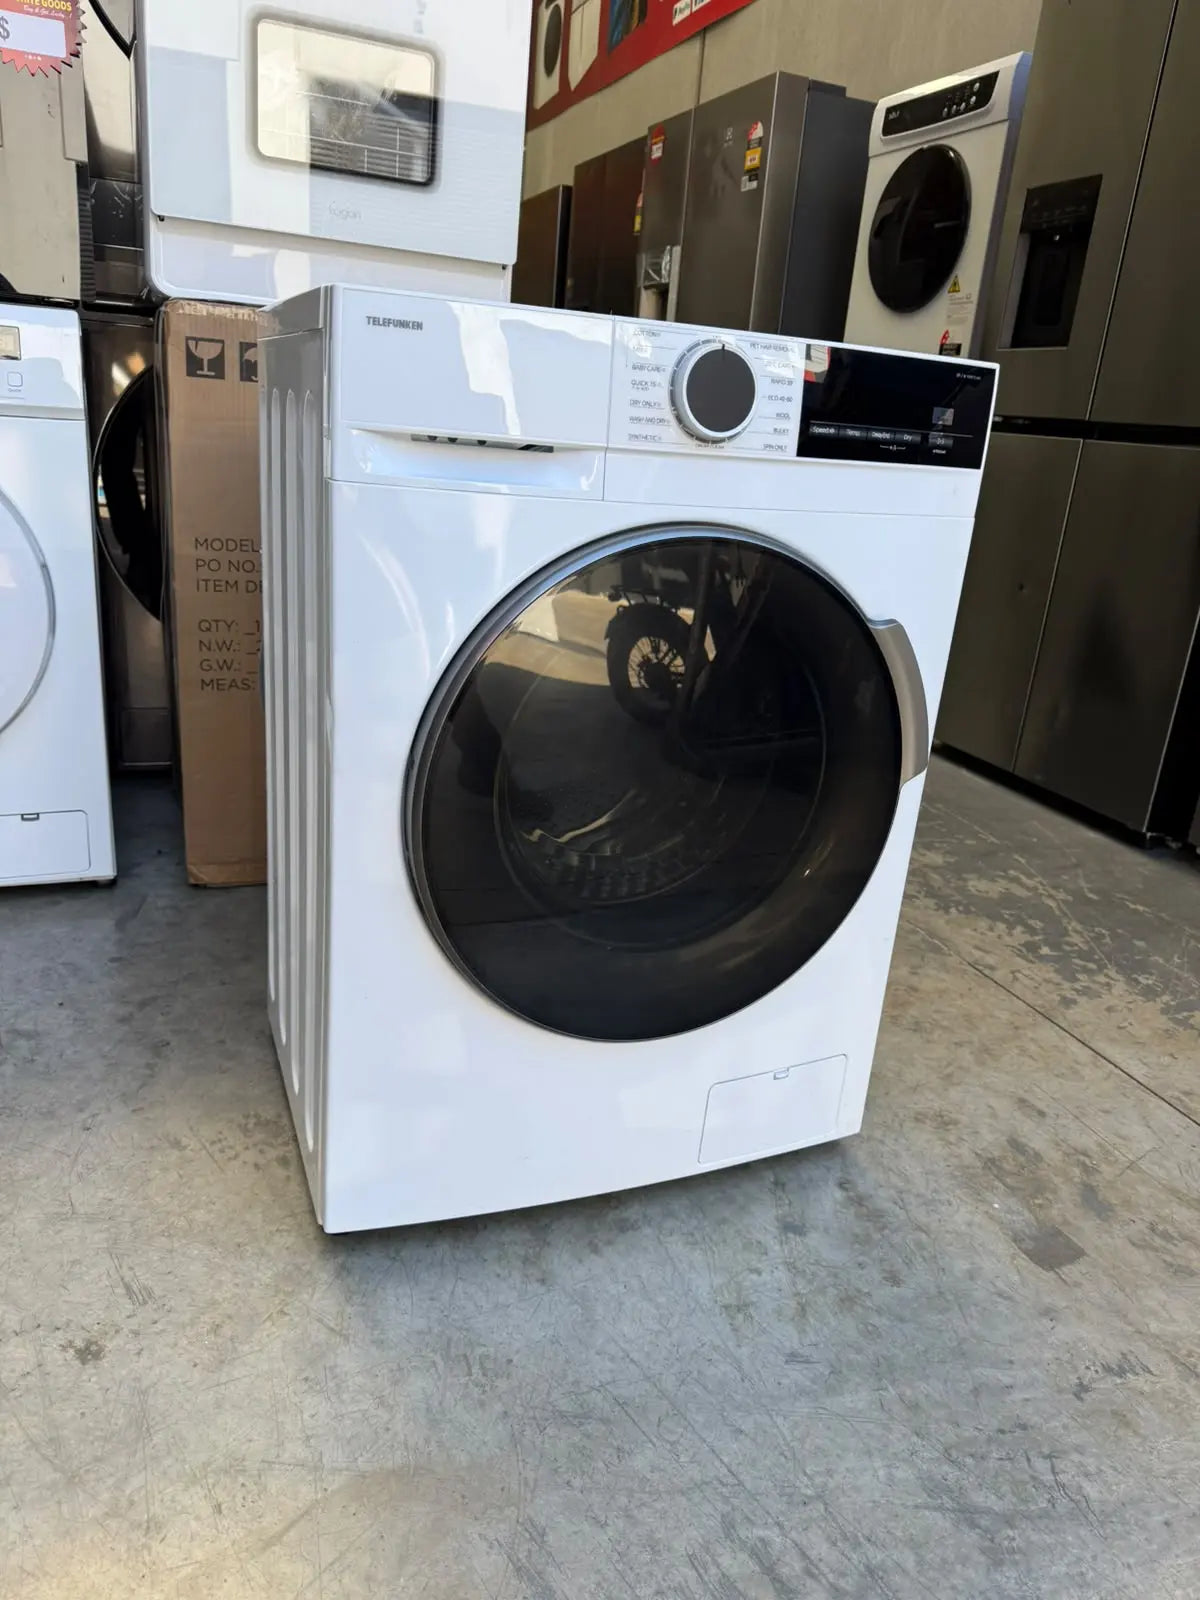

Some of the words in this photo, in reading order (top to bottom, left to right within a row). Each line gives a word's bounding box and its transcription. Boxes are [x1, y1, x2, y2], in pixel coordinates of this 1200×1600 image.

[42, 0, 73, 11] GOODS
[366, 316, 423, 330] TELEFUNKEN
[630, 399, 641, 407] DRY
[642, 400, 657, 408] ONLY
[196, 559, 221, 573] PO
[196, 579, 238, 593] ITEM
[198, 619, 240, 633] QTY:
[201, 679, 256, 691] MEAS:
